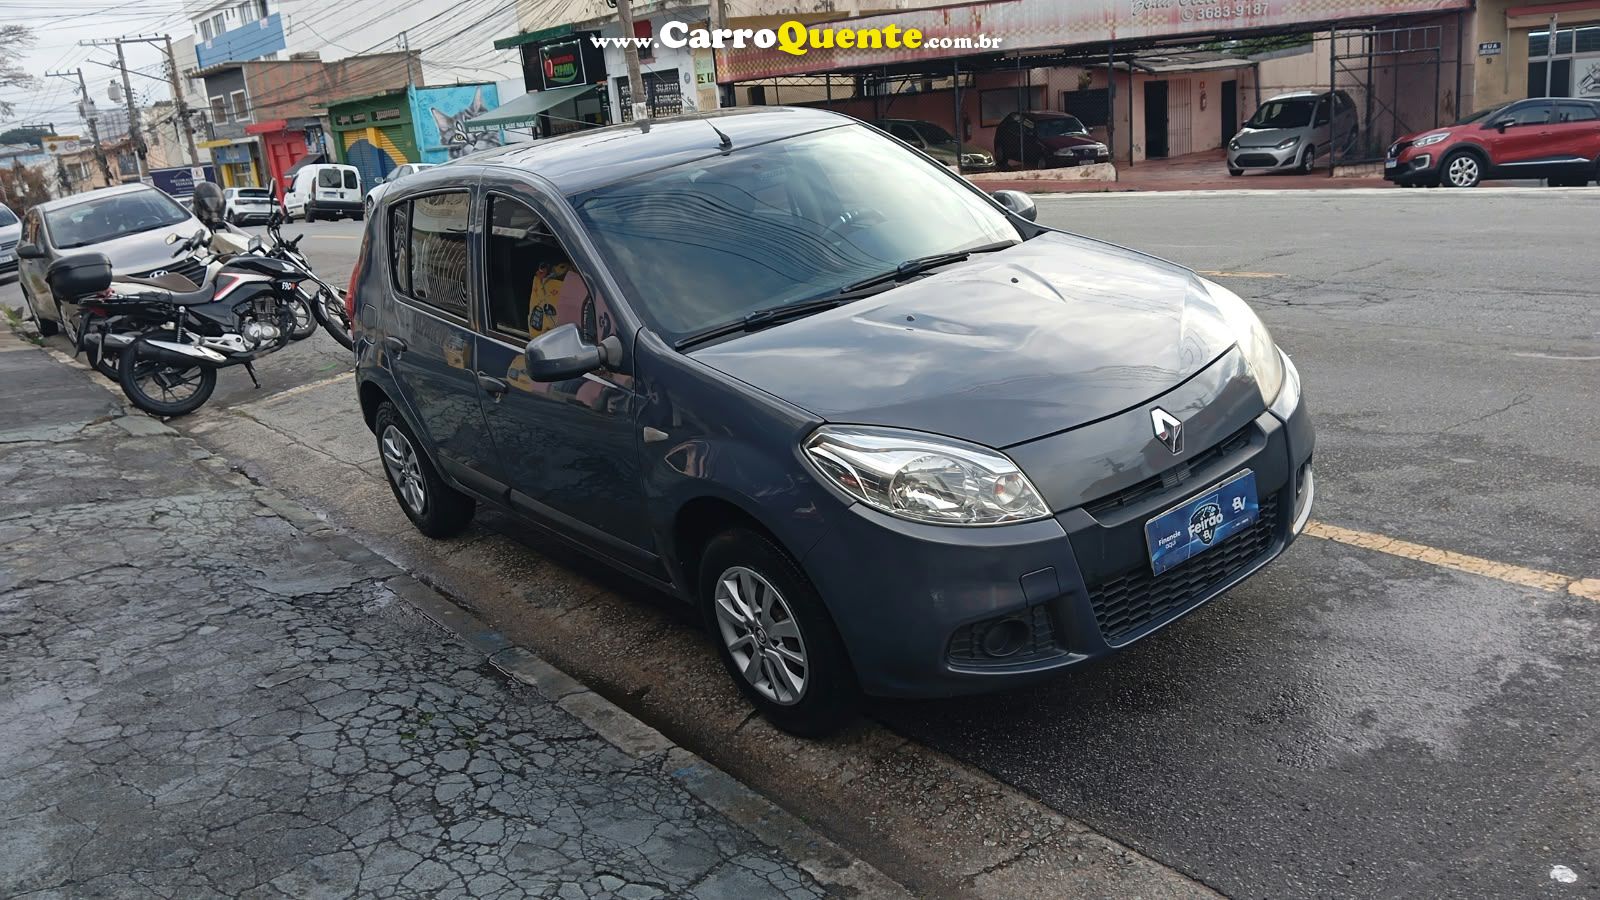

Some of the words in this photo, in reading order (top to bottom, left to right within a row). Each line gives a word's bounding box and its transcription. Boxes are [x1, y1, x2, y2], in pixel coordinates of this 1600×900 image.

[1197, 2, 1269, 20] 3683-9187
[1188, 513, 1223, 538] Feirão
[1158, 531, 1181, 546] Financie
